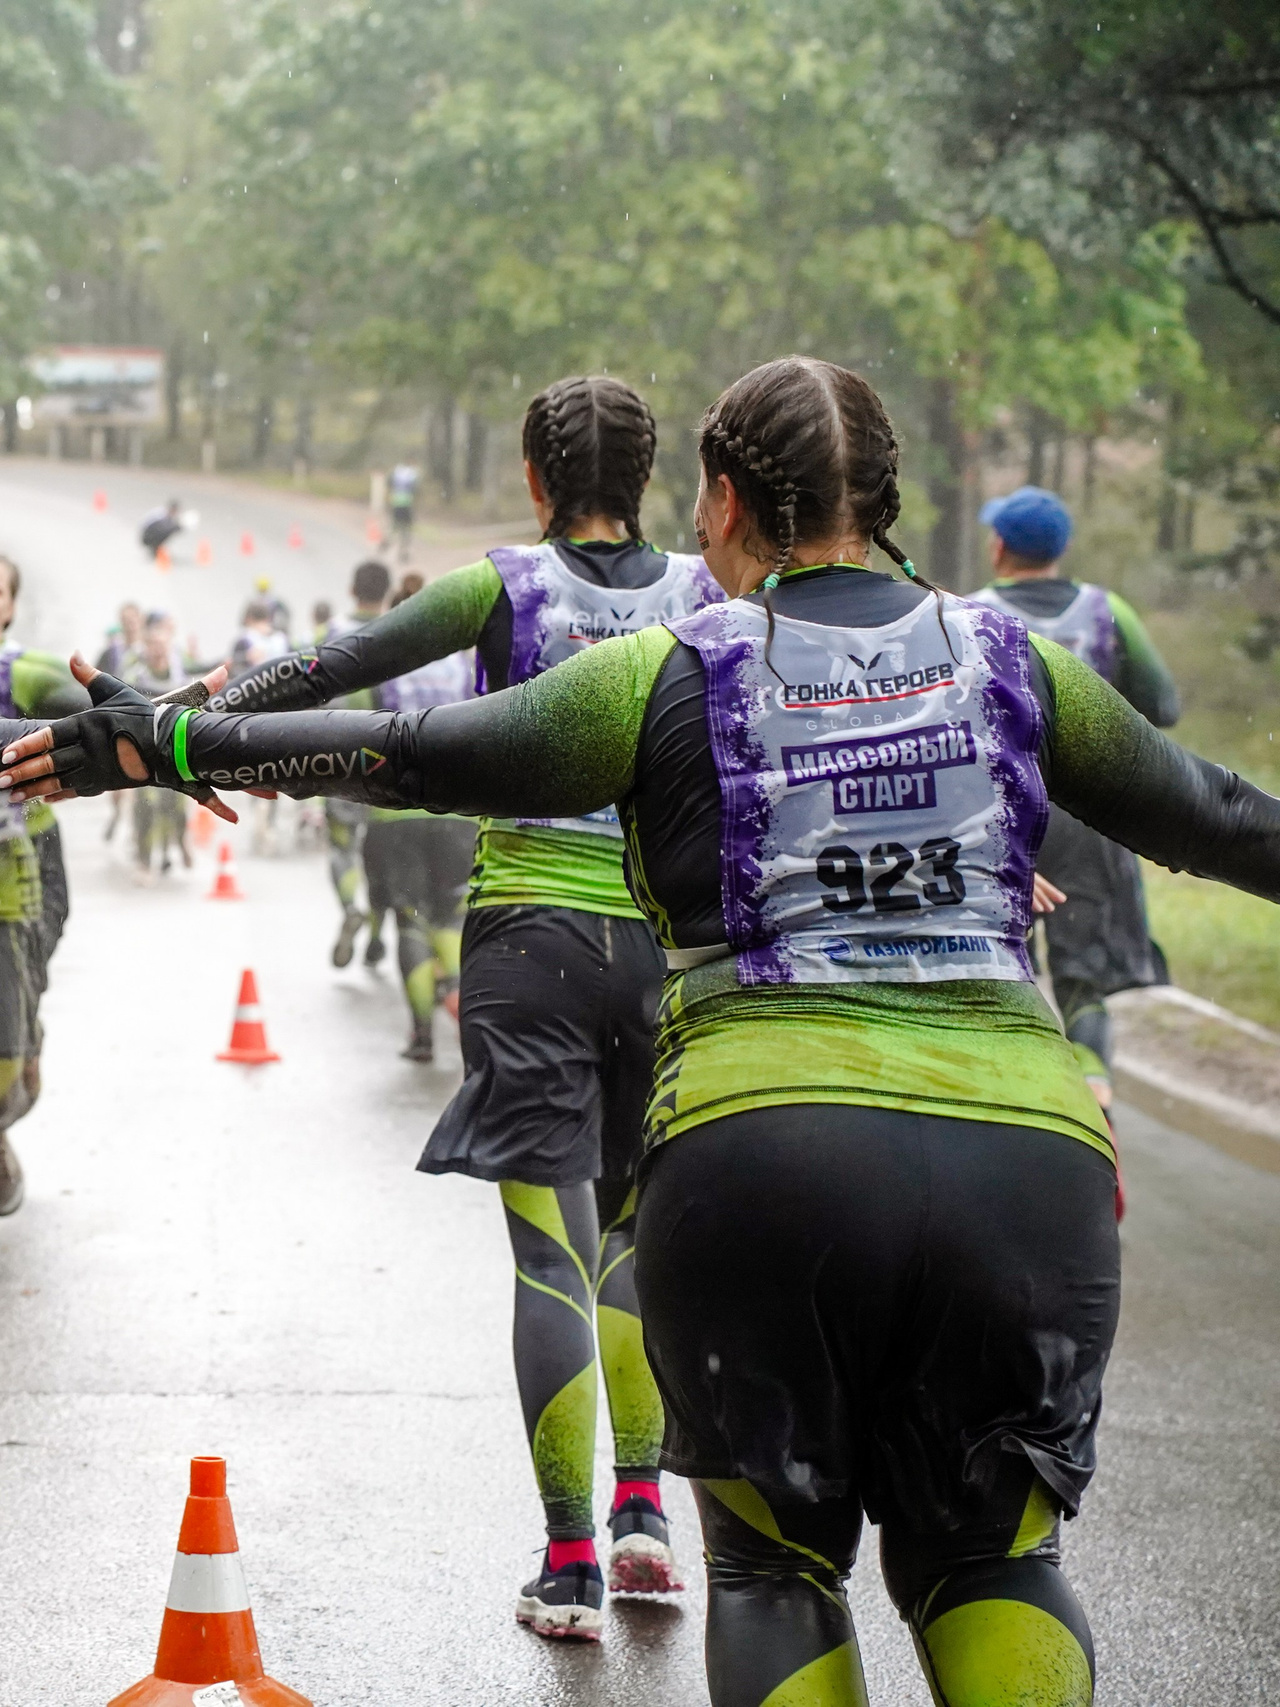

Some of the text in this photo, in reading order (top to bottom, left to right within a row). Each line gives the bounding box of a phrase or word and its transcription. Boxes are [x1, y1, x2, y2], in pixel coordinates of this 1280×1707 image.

[210, 658, 304, 712] eenwa
[784, 680, 859, 701] ГОНКА
[866, 663, 954, 695] ГЕРОЕВ
[806, 709, 924, 731] GLOBA
[791, 717, 969, 779] МАССОВЫЙ
[197, 750, 357, 785] reenway
[839, 772, 928, 810] СТАРТ
[817, 837, 966, 913] 923
[862, 936, 991, 957] ГАЗПРОМБАНК
